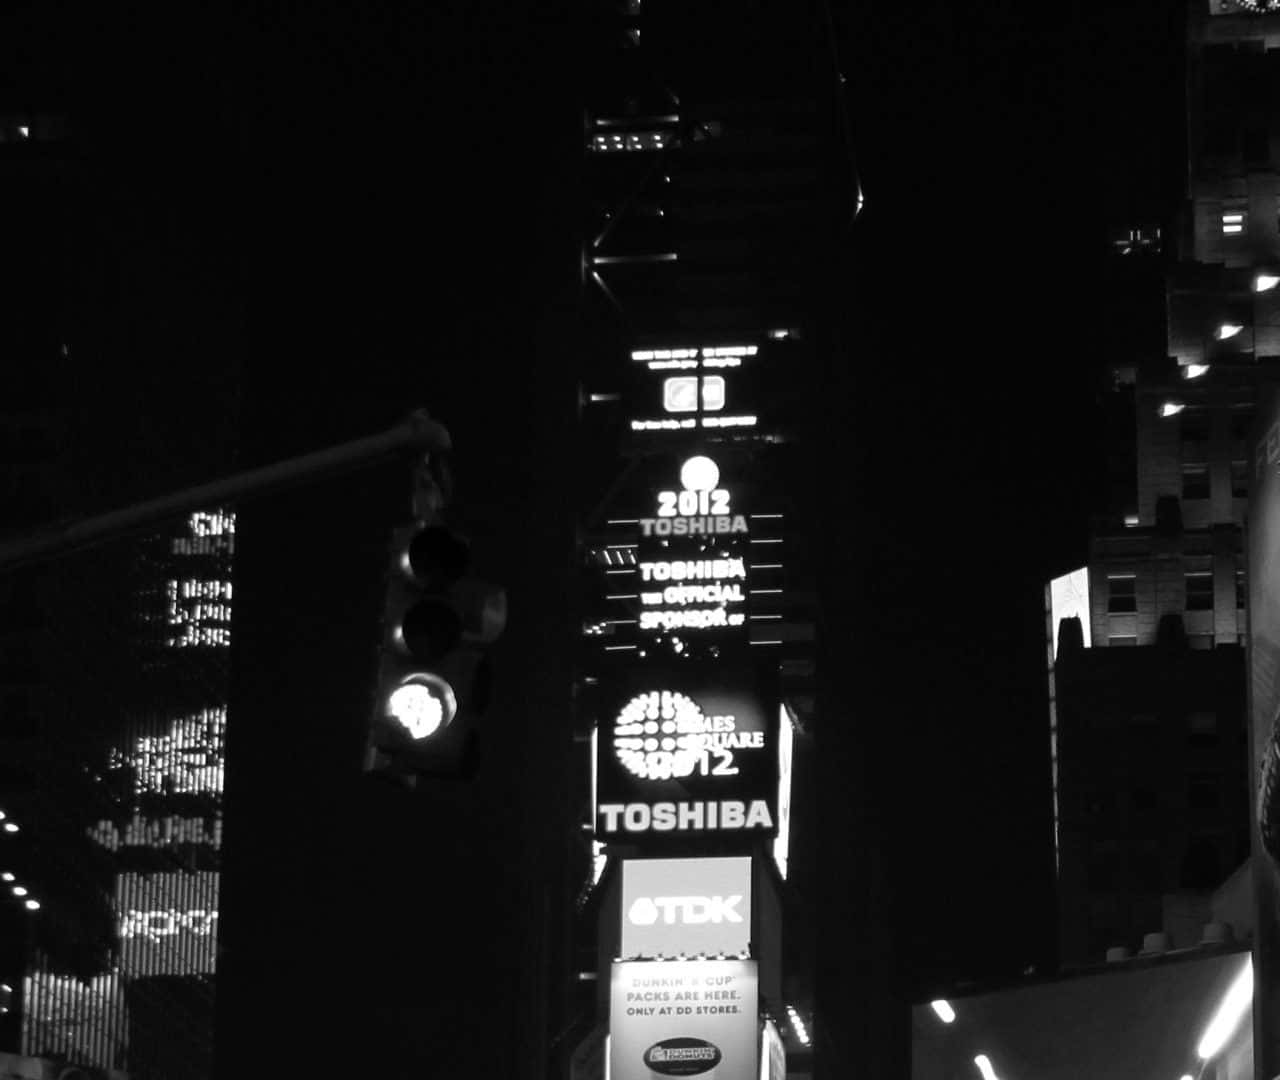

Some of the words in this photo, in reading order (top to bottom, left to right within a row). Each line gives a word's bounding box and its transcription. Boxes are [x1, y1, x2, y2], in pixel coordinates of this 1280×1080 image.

[657, 489, 732, 518] 2012
[640, 515, 749, 537] TOSHIBA
[640, 556, 747, 581] TOSHIBA
[639, 607, 728, 630] SPONSOR
[599, 800, 774, 833] TOSHIBA
[654, 894, 744, 925] TDK
[627, 991, 671, 1003] PACKS
[675, 990, 700, 1002] ARE
[626, 1006, 656, 1017] ONLY
[658, 1006, 673, 1016] AT
[676, 1005, 693, 1016] DD
